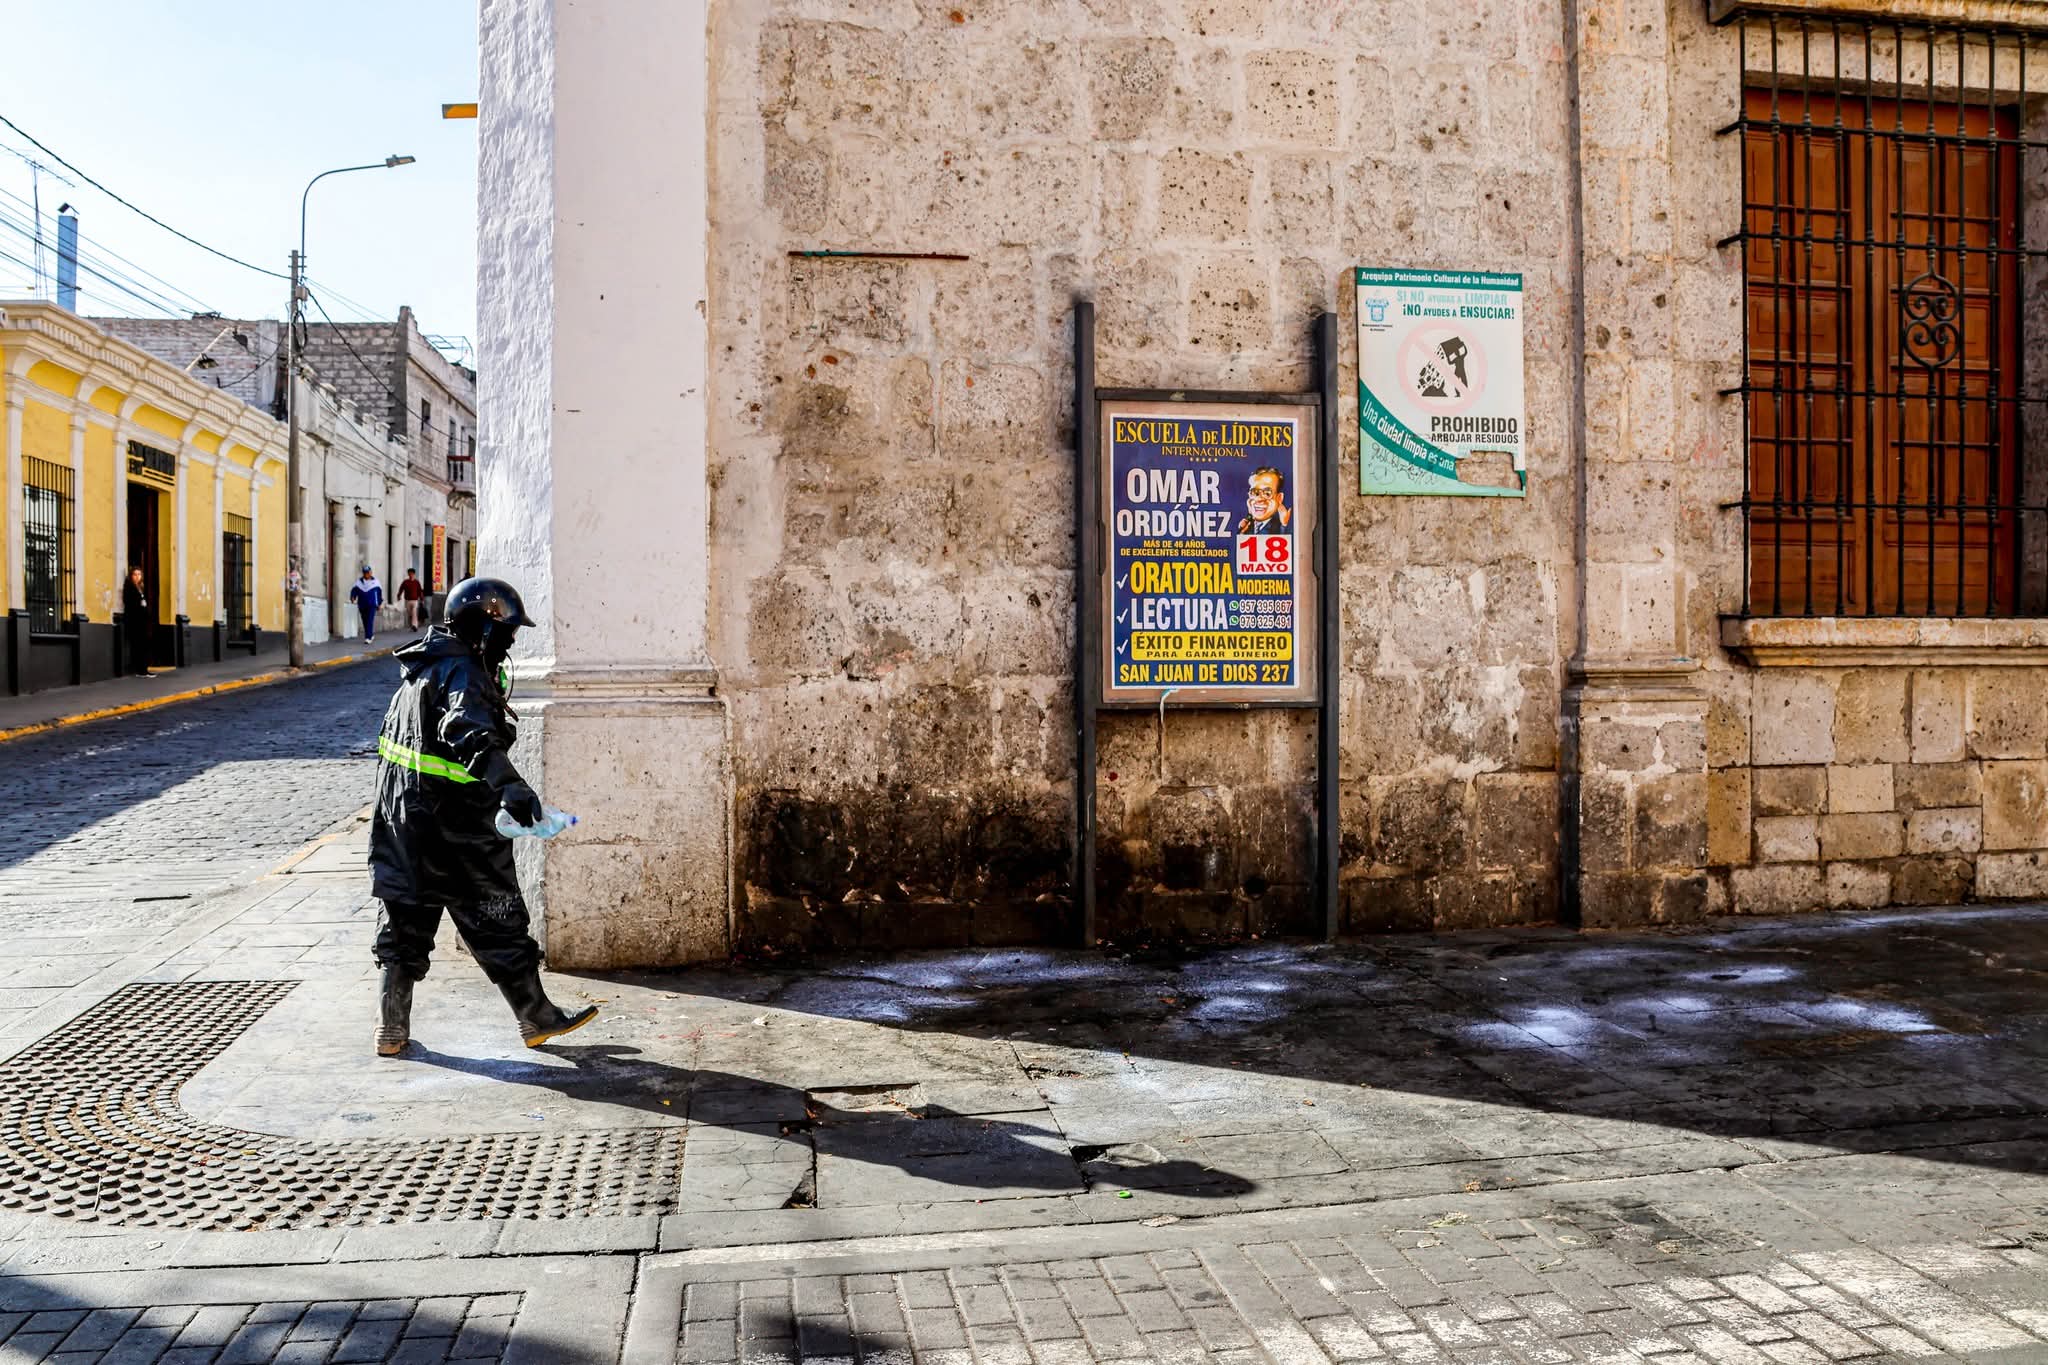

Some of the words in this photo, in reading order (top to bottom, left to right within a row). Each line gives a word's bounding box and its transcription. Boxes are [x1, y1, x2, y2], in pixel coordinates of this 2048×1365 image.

[1362, 272, 1393, 283] Arequipa
[1395, 272, 1432, 282] Patrimonio
[1434, 274, 1460, 283] Cultural
[1463, 274, 1471, 284] de
[1473, 275, 1479, 284] la
[1481, 276, 1519, 286] Humanidad
[1410, 290, 1424, 302] NO
[1465, 292, 1508, 305] LIMPIAR
[1403, 304, 1420, 316] ¡NO
[1424, 308, 1450, 317] AYUDES
[1452, 309, 1457, 317] A
[1460, 305, 1514, 319] ENSUCIAR!
[1363, 399, 1378, 425] Una
[1377, 416, 1404, 445] ciudad
[1402, 432, 1428, 459] limpia
[1428, 452, 1438, 464] es
[1431, 416, 1517, 433] PROHIBIDO
[1115, 421, 1196, 444] ESCUELA
[1202, 430, 1218, 444] DE
[1221, 422, 1292, 447] LÍDERES
[1475, 434, 1519, 444] RESIDUOS
[1162, 447, 1247, 458] INTERNACIONAL
[1126, 468, 1221, 504] OMAR
[1117, 504, 1232, 538] ORDÓÑEZ
[1144, 539, 1160, 548] MÁS
[1162, 540, 1172, 548] DE
[1185, 539, 1206, 548] AÑOS
[1240, 536, 1289, 562] 18
[1120, 548, 1131, 556] DE
[1132, 548, 1179, 557] EXCELENTES
[1181, 549, 1229, 557] RESULTADOS
[1241, 564, 1289, 573] MAYO
[1130, 561, 1234, 595] ORATORIA
[1237, 579, 1290, 596] MODERNA
[1131, 598, 1228, 630] LECTURA
[1240, 600, 1256, 613] 957
[1257, 600, 1274, 613] 395
[1275, 600, 1292, 613] 867
[1240, 615, 1256, 628] 979
[1257, 615, 1274, 628] 325
[1275, 615, 1291, 628] 491
[1136, 632, 1183, 650] ÉXITO
[1189, 636, 1287, 650] FINANCIERO
[1120, 664, 1149, 682] SAN
[1154, 664, 1193, 682] JUAN
[1199, 664, 1218, 682] DE
[1223, 664, 1257, 682] DIOS
[1262, 664, 1290, 682] 237
